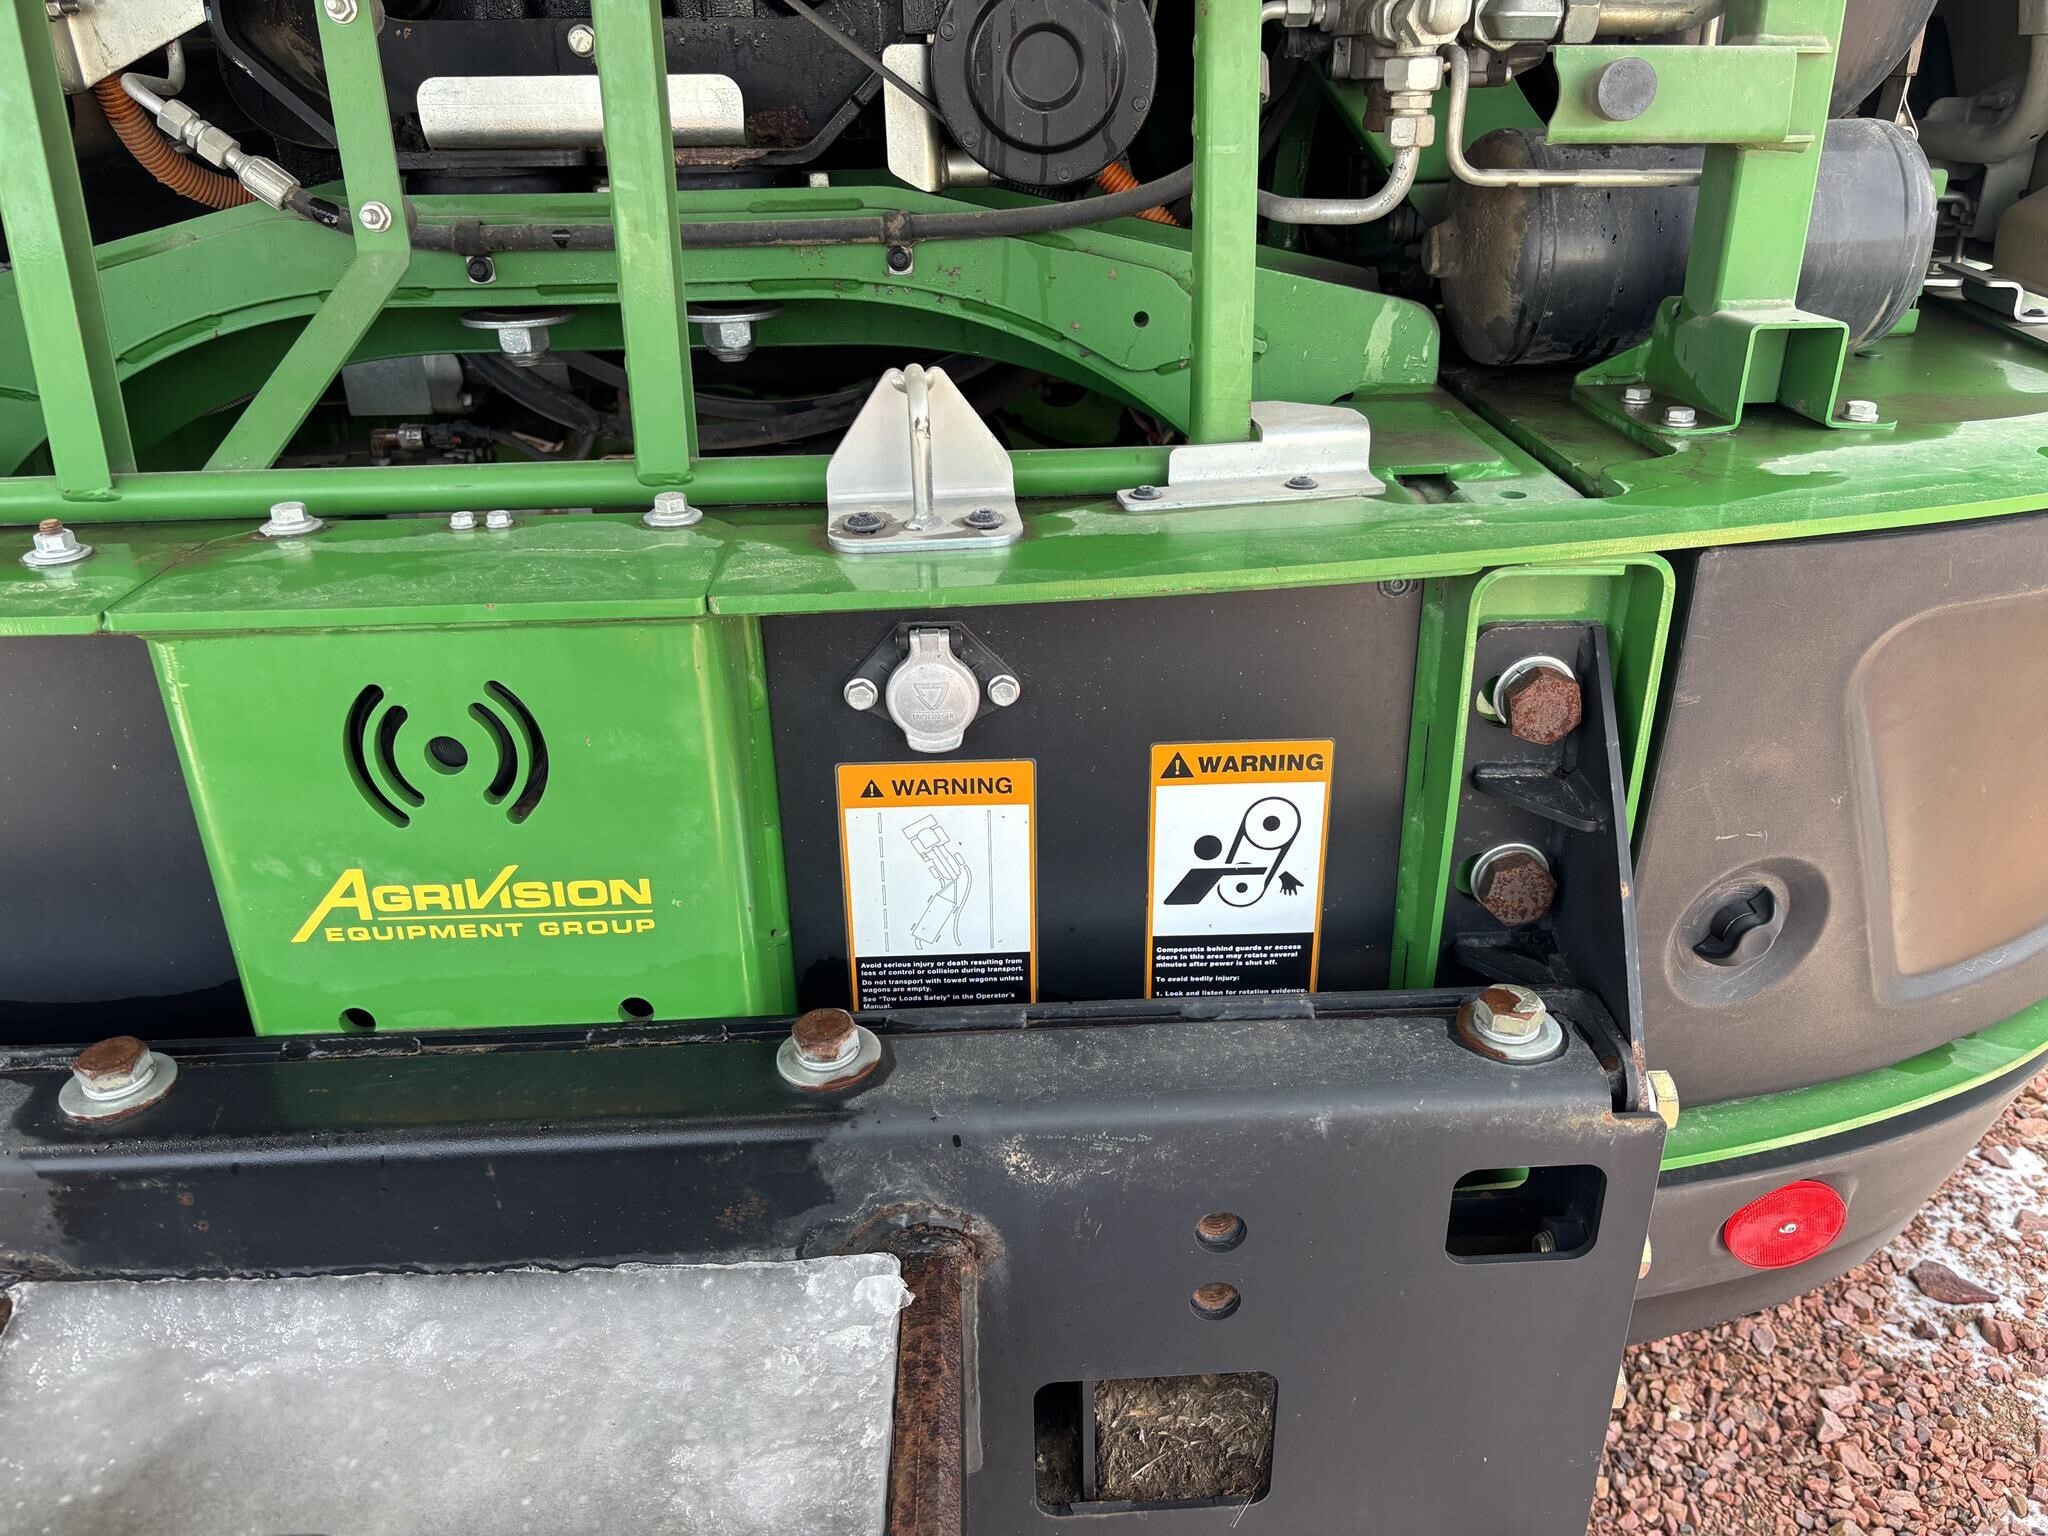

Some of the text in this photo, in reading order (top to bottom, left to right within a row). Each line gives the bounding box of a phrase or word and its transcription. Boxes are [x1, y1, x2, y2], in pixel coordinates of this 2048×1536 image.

[1198, 754, 1324, 773] WARNING
[892, 777, 1013, 796] WARNING
[325, 918, 656, 942] EQUIPMENT GROUP
